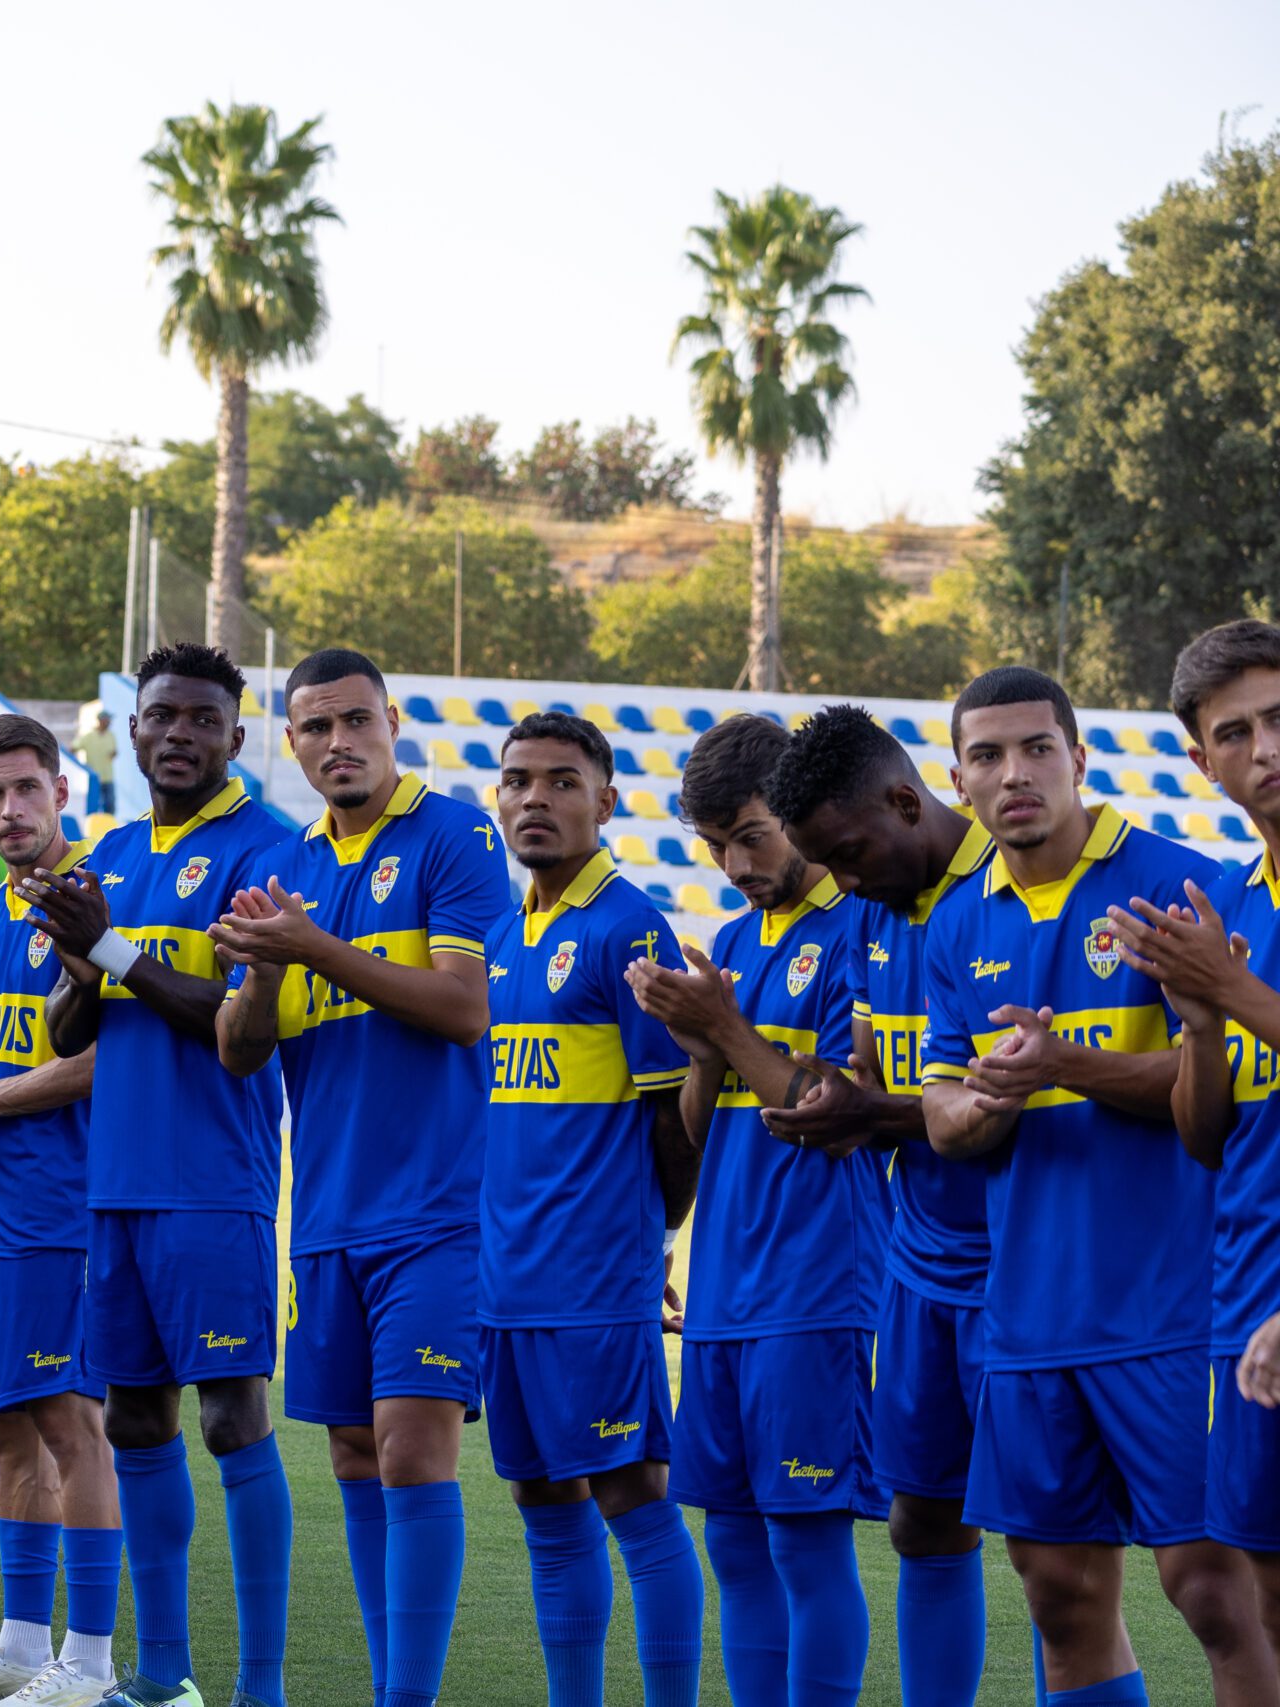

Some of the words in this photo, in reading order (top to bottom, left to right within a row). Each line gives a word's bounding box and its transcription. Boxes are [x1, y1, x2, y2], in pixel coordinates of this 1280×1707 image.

[969, 956, 1011, 983] tactique
[200, 1330, 248, 1354] tactique
[26, 1350, 72, 1372] tactique
[415, 1346, 462, 1374] tactique
[591, 1418, 641, 1441] tactique
[780, 1457, 835, 1486] tactique
